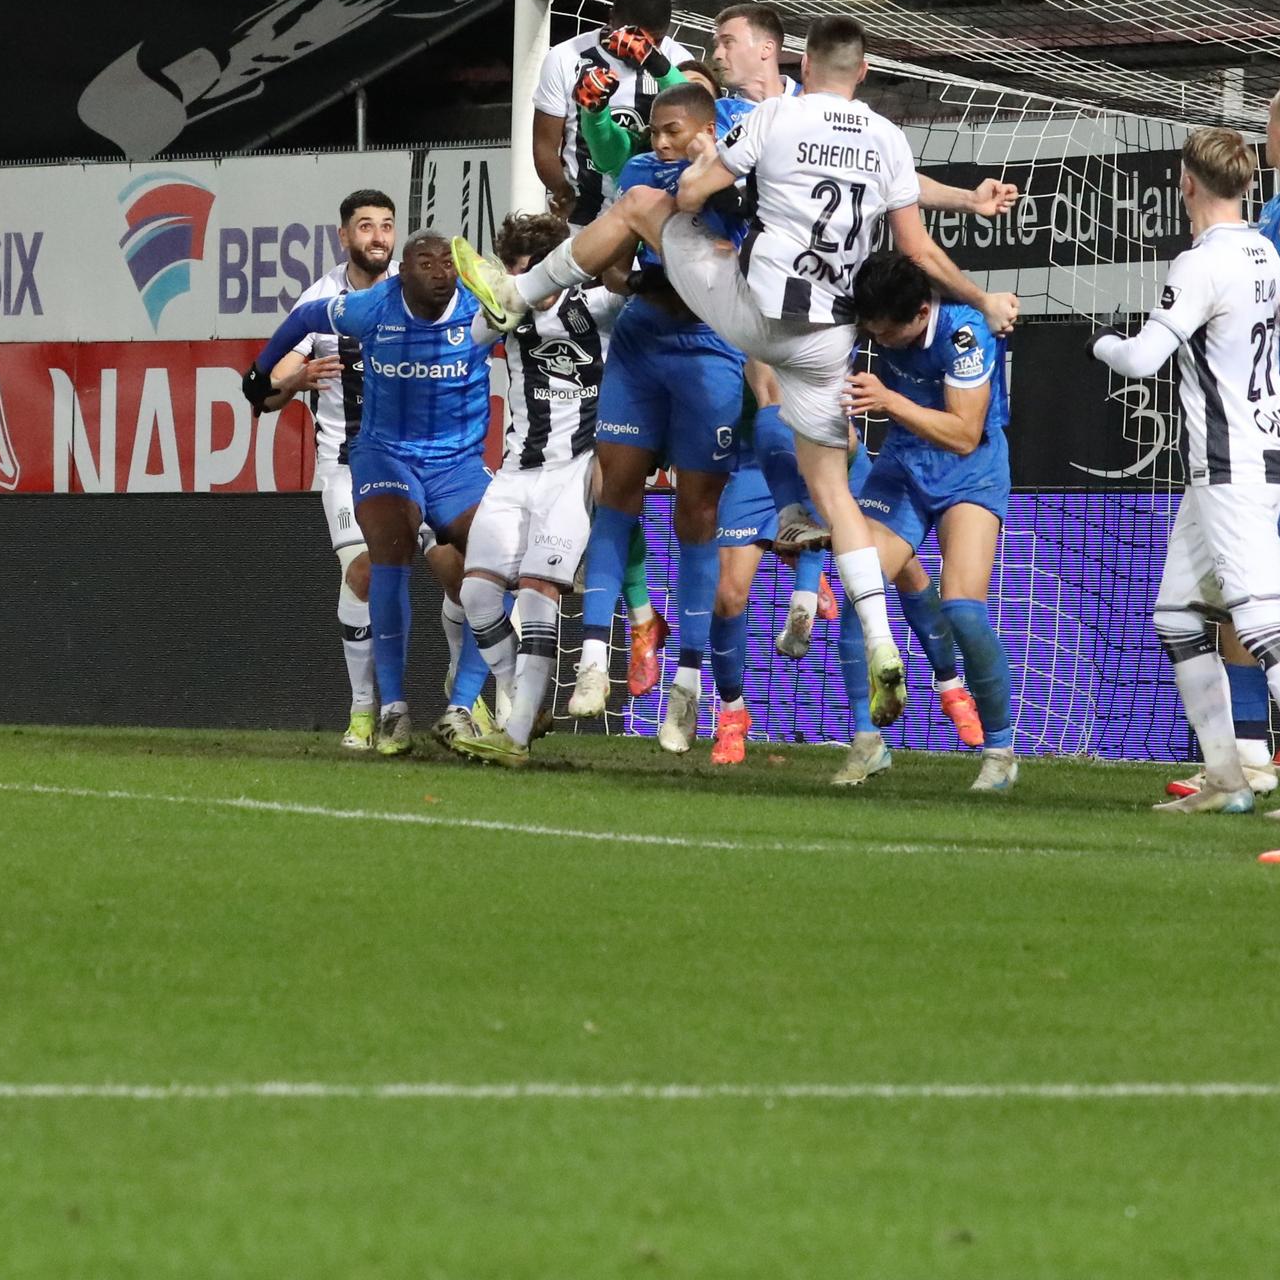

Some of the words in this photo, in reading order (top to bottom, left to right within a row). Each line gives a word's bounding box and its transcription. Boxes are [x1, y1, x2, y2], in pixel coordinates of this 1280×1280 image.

[823, 111, 870, 127] UNIBET
[796, 141, 882, 174] SCHEIDLER
[809, 179, 867, 254] 21
[1054, 174, 1097, 243] du
[533, 384, 598, 400] NAPOLEON
[602, 422, 640, 436] cegeka
[372, 481, 409, 492] cegeka
[534, 534, 574, 551] UMONS
